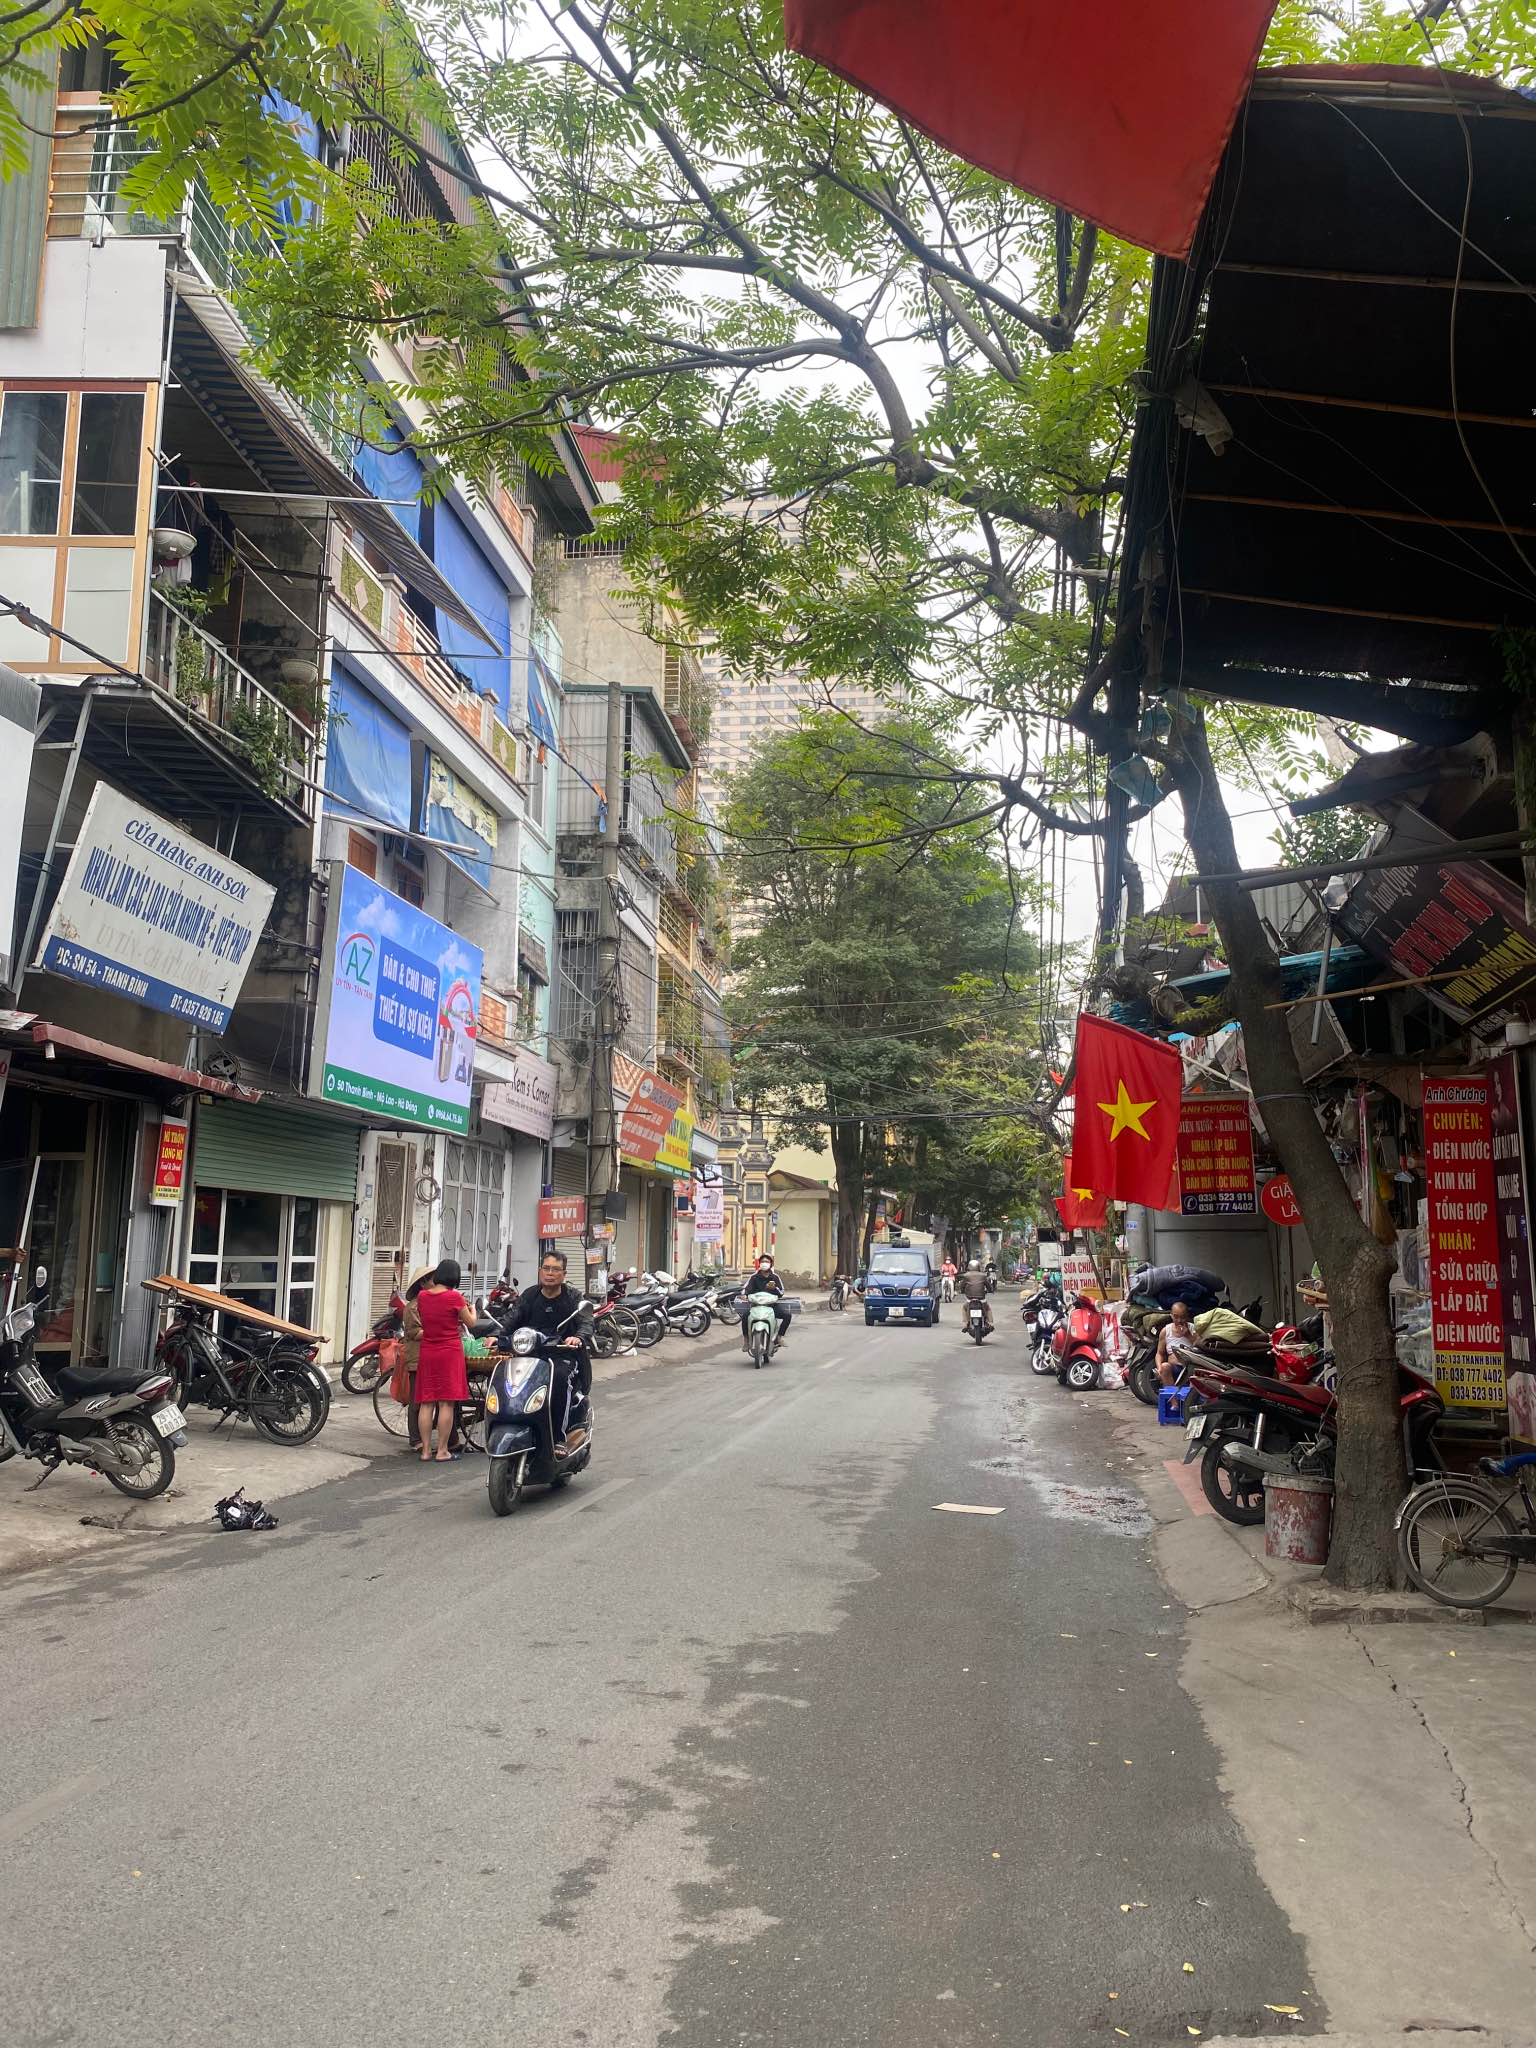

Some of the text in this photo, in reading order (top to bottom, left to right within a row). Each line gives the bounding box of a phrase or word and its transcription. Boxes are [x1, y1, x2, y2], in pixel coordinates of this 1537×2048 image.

[125, 820, 250, 900] CỬA HÀNG ANH SƠN
[80, 844, 117, 906] NHẬN
[106, 854, 135, 909] LÀM
[125, 865, 151, 918] CÁC
[141, 879, 169, 935] LOẠI
[160, 880, 184, 934] CỬA
[175, 895, 206, 945] NHÔM
[195, 903, 217, 957] HỆ
[212, 911, 235, 965] VIỆT
[226, 920, 252, 965] PHÁP
[72, 952, 87, 974] SN
[86, 959, 98, 978] 54
[102, 965, 130, 991] THANH
[128, 975, 149, 998] BÌNH
[346, 942, 373, 986] AZ
[383, 953, 437, 1001] BÁN & CHO THUÊ
[170, 993, 183, 1011] ĐT:
[181, 999, 200, 1016] 0357
[379, 993, 434, 1044] THIẾT BỊ SỰ KIỆN
[532, 1076, 550, 1105] Corner
[1425, 1087, 1487, 1105] Anh Chương
[1181, 1104, 1200, 1113] ANH
[1433, 1109, 1483, 1130] CHUYÊN:
[1433, 1138, 1490, 1164] ĐIỆN NƯỚC
[1434, 1168, 1476, 1190] KIM KHÍ
[1218, 1192, 1235, 1201] 523
[1236, 1192, 1253, 1201] 919
[1270, 1182, 1294, 1199] GIẶ
[551, 1207, 577, 1220] TIVI
[1199, 1203, 1214, 1212] 038
[1232, 1202, 1253, 1211] 4402
[1281, 1201, 1301, 1218] LÀ
[1435, 1195, 1488, 1225] TỔNG HỢP
[542, 1223, 566, 1234] AMPLY
[1439, 1228, 1476, 1255] NHẬN:
[1063, 1258, 1077, 1274] SỬA
[1440, 1257, 1464, 1281] SỬA
[1466, 1260, 1499, 1282] CHỮA
[1440, 1286, 1463, 1312] LẮP
[1465, 1289, 1489, 1316] ĐẶT
[1436, 1321, 1501, 1347] ĐIỆN NƯỚC
[1435, 1354, 1448, 1364] ĐC:
[1449, 1354, 1461, 1364] 133
[1462, 1355, 1484, 1365] THANH
[1436, 1367, 1503, 1383] ĐT: 038 777 4402
[1450, 1386, 1503, 1401] 0334 523 919
